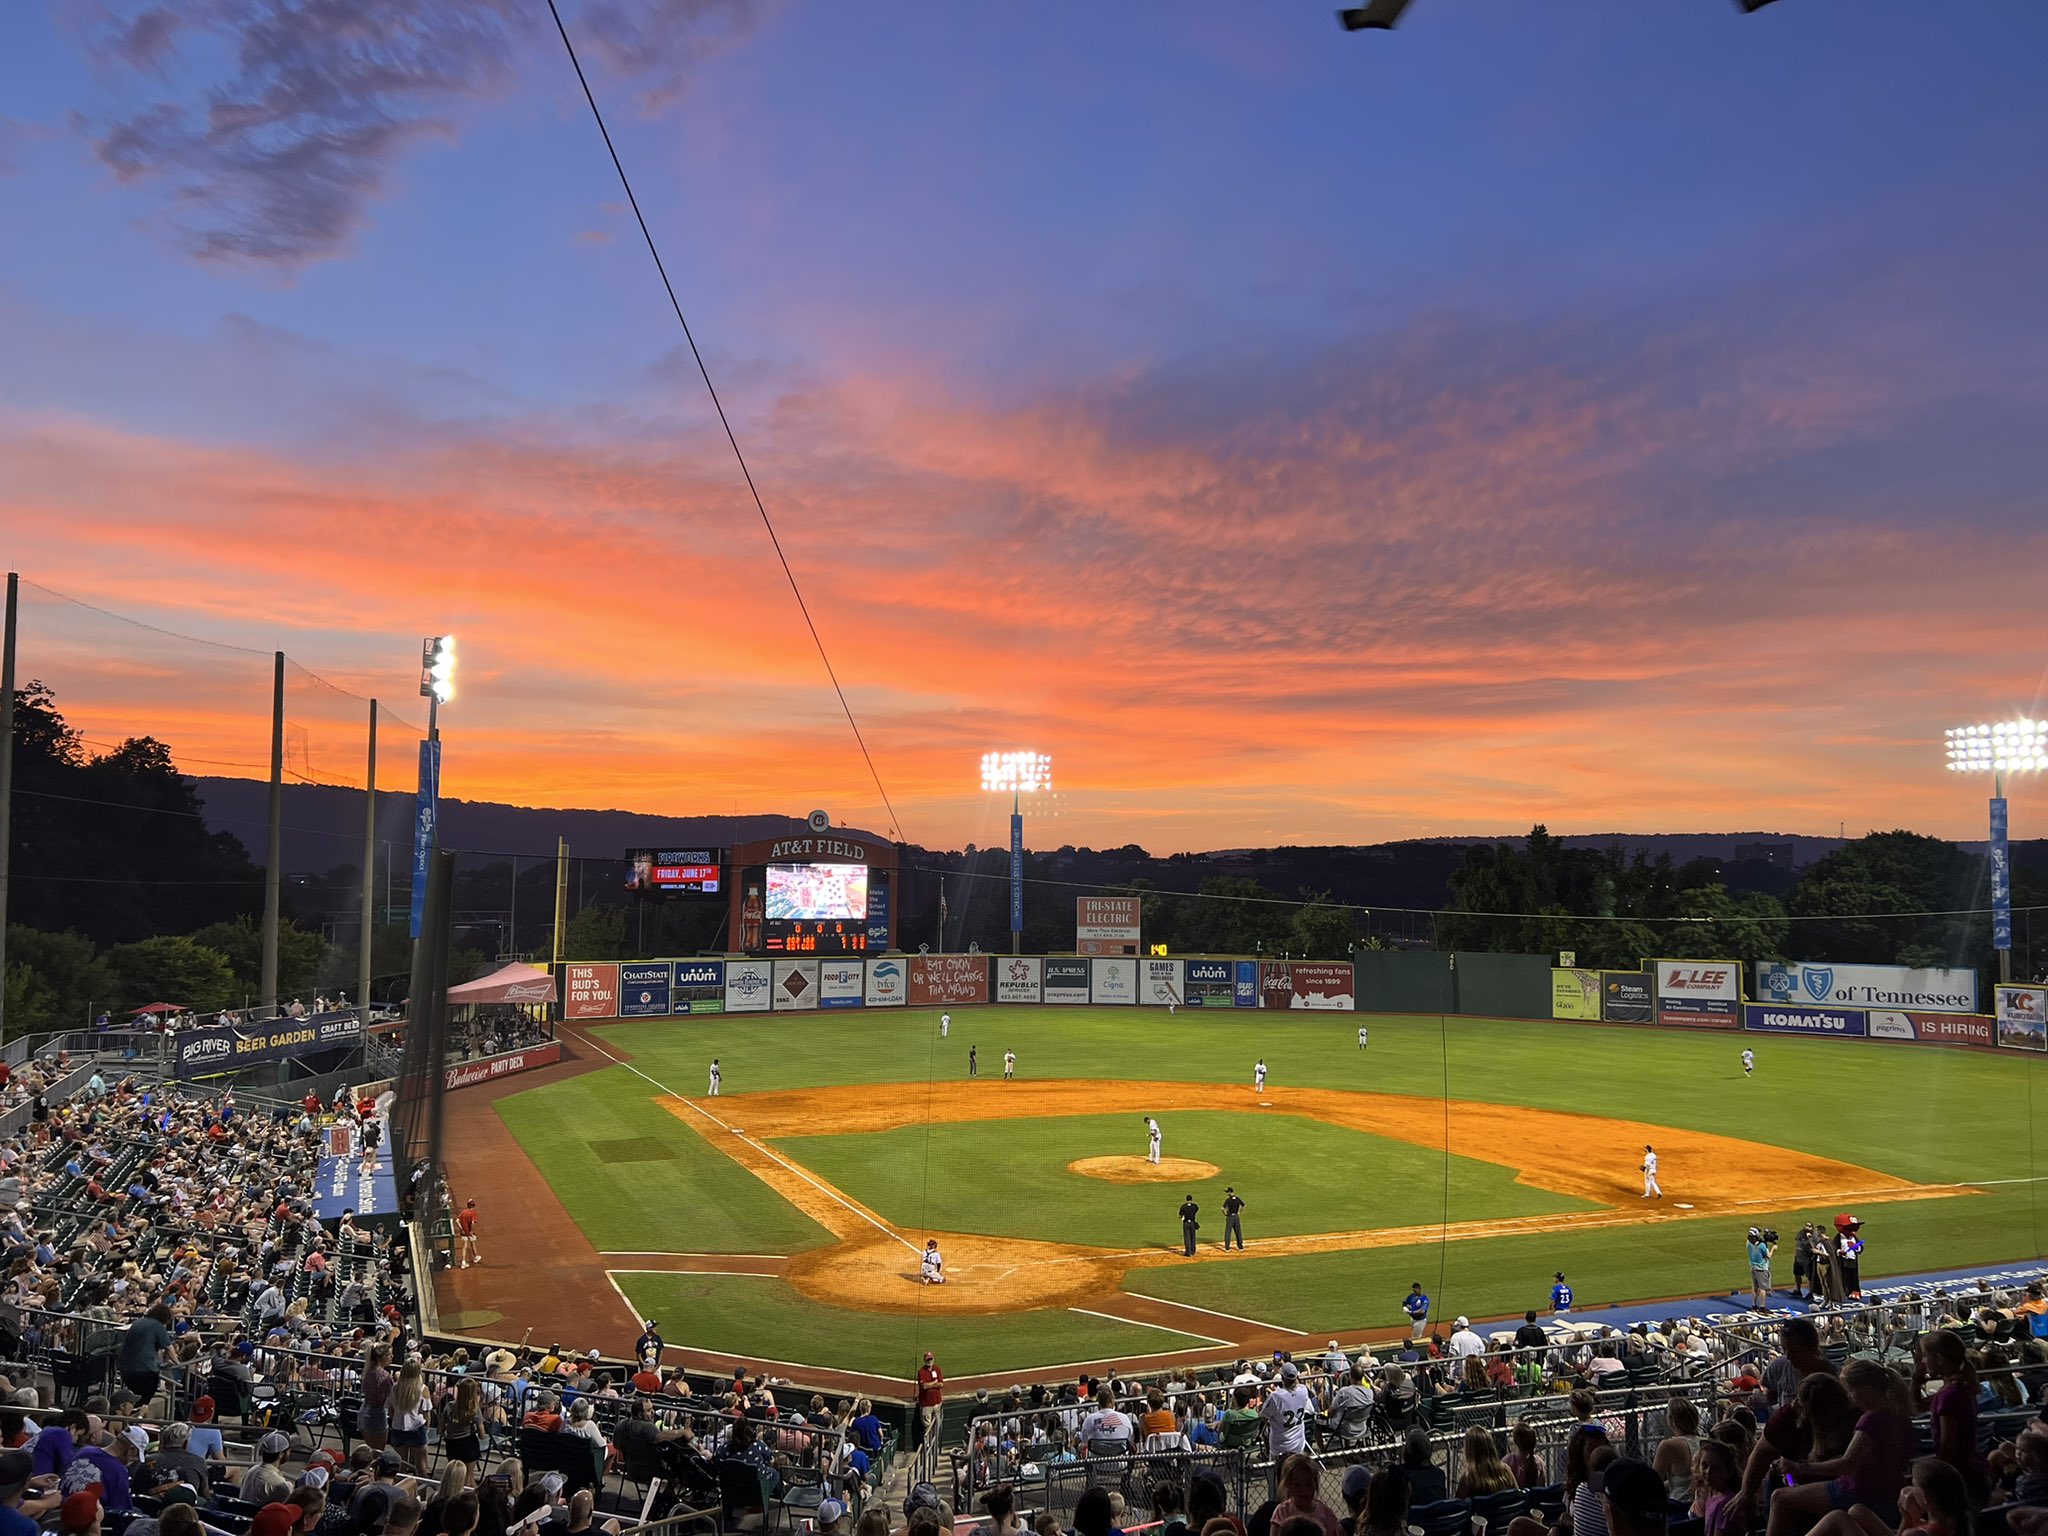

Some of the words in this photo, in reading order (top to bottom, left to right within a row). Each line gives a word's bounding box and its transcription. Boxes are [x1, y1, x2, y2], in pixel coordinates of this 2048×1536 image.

[771, 840, 813, 858] AT&T
[817, 840, 865, 860] FIELD
[657, 852, 711, 864] FIREWORKS
[682, 868, 698, 878] JUNE
[1086, 901, 1133, 911] TRI-STATE
[1086, 913, 1132, 923] ELECTRIC
[795, 924, 801, 933] 0
[817, 924, 823, 933] 0
[927, 960, 943, 971] EAT
[1150, 962, 1174, 972] GAMES
[572, 968, 593, 978] THIS
[680, 968, 717, 982] unum
[1192, 966, 1227, 978] unum
[1295, 967, 1333, 976] refreshing
[913, 972, 924, 984] OR
[954, 970, 984, 982] CHARGE
[1689, 971, 1728, 985] LEE
[572, 979, 600, 989] BUD'S
[877, 978, 895, 988] tvfcu
[1103, 981, 1124, 990] Cigna
[1686, 981, 1724, 991] COMPANY
[509, 987, 546, 995] Budweiser
[928, 984, 944, 996] THA
[947, 983, 975, 997] MOUND
[1620, 985, 1643, 993] Steam
[571, 992, 589, 1001] FOR
[592, 990, 613, 1000] YOU.
[1620, 992, 1648, 1000] Logistics
[1835, 986, 1857, 1001] of
[1860, 987, 1970, 1007] Tennessee
[2006, 992, 2034, 1012] KC
[1663, 1015, 1732, 1024] leecompany.com/careers
[2006, 1012, 2034, 1020] KUBOTA
[1763, 1013, 1846, 1030] KOMATSU
[1921, 1022, 1936, 1033] IS
[1939, 1022, 1989, 1038] HIRING
[183, 1041, 201, 1060] BIG
[202, 1038, 231, 1053] RIVER
[235, 1036, 266, 1054] BEER
[269, 1029, 316, 1048] GARDEN
[320, 1023, 342, 1034] CRAFT
[344, 1020, 360, 1031] BEER
[445, 1067, 488, 1089] Budweiser
[490, 1060, 509, 1075] PARTY
[509, 1055, 524, 1070] DECK
[1560, 1294, 1570, 1304] 23
[1283, 1407, 1305, 1428] 22
